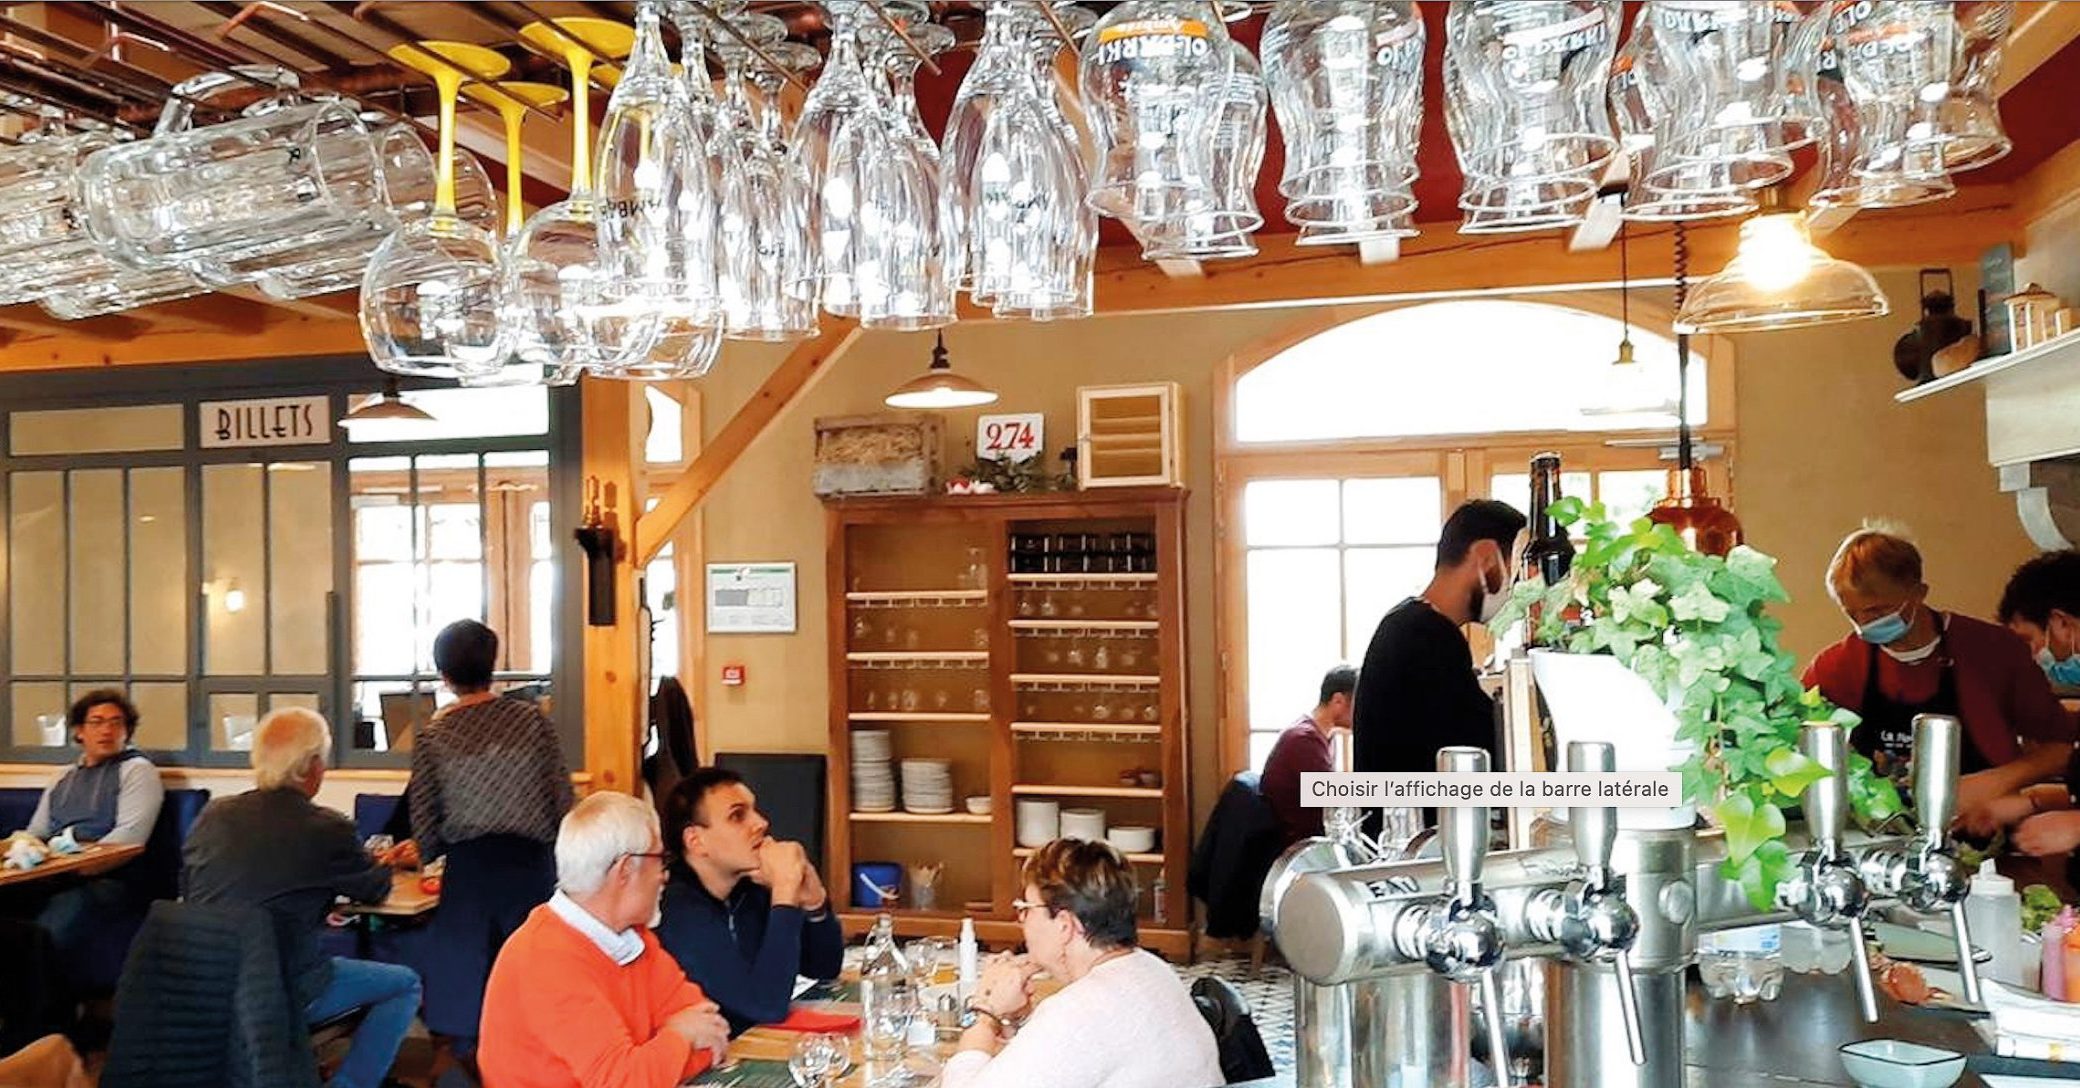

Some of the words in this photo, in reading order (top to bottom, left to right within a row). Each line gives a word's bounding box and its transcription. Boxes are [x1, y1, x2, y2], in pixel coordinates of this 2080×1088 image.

[214, 403, 312, 440] BILLETS
[986, 422, 1035, 450] 274
[1366, 875, 1421, 899] EAU
